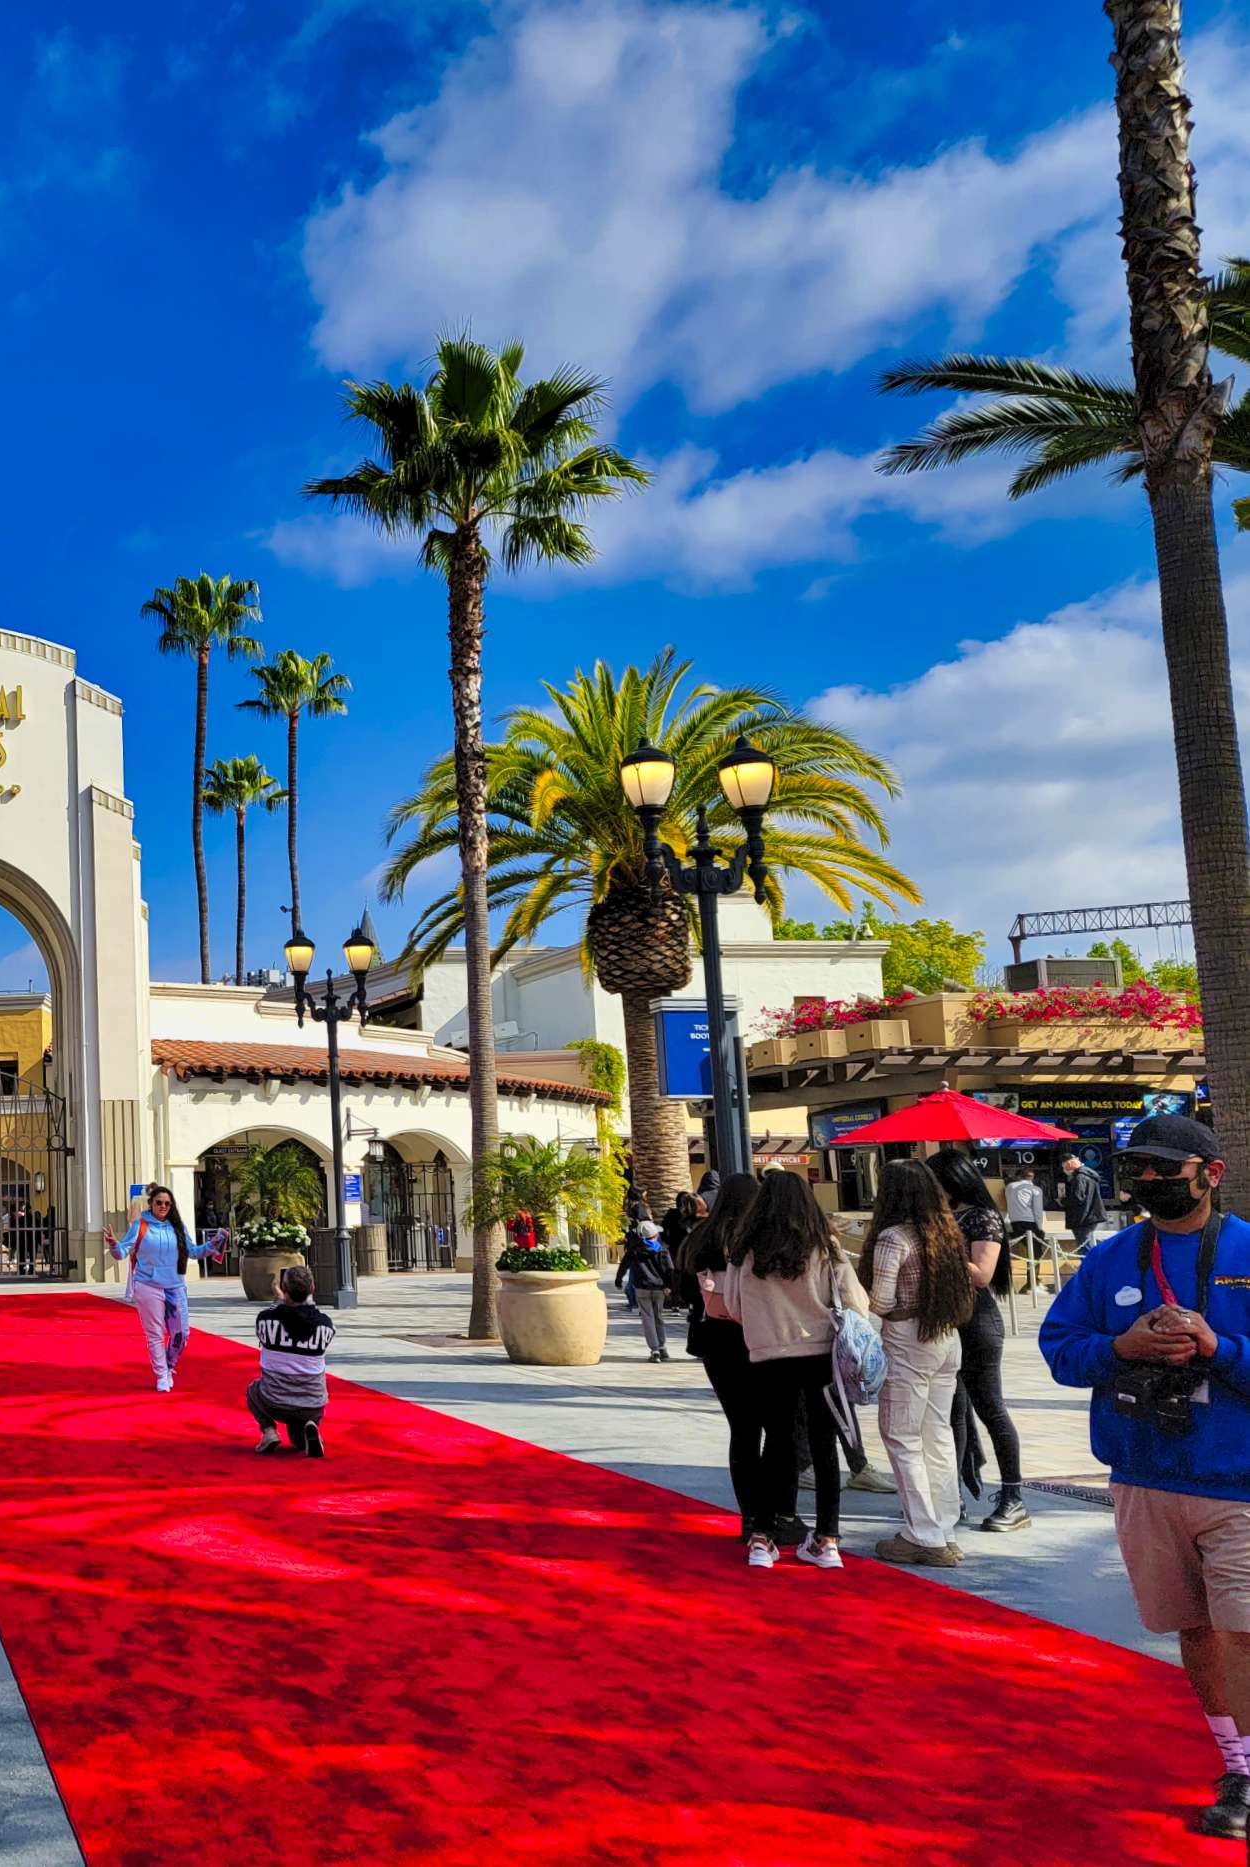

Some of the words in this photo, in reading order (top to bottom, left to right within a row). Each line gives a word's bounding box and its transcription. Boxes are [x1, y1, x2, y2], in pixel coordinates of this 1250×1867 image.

[1021, 1100, 1038, 1109] GET
[1040, 1100, 1053, 1109] AN
[1054, 1100, 1089, 1109] ANNUAL
[1091, 1100, 1113, 1109] PASS
[1115, 1100, 1143, 1109] TODAY
[981, 1157, 988, 1168] 9
[1017, 1152, 1035, 1164] 10
[258, 1319, 292, 1347] OVE
